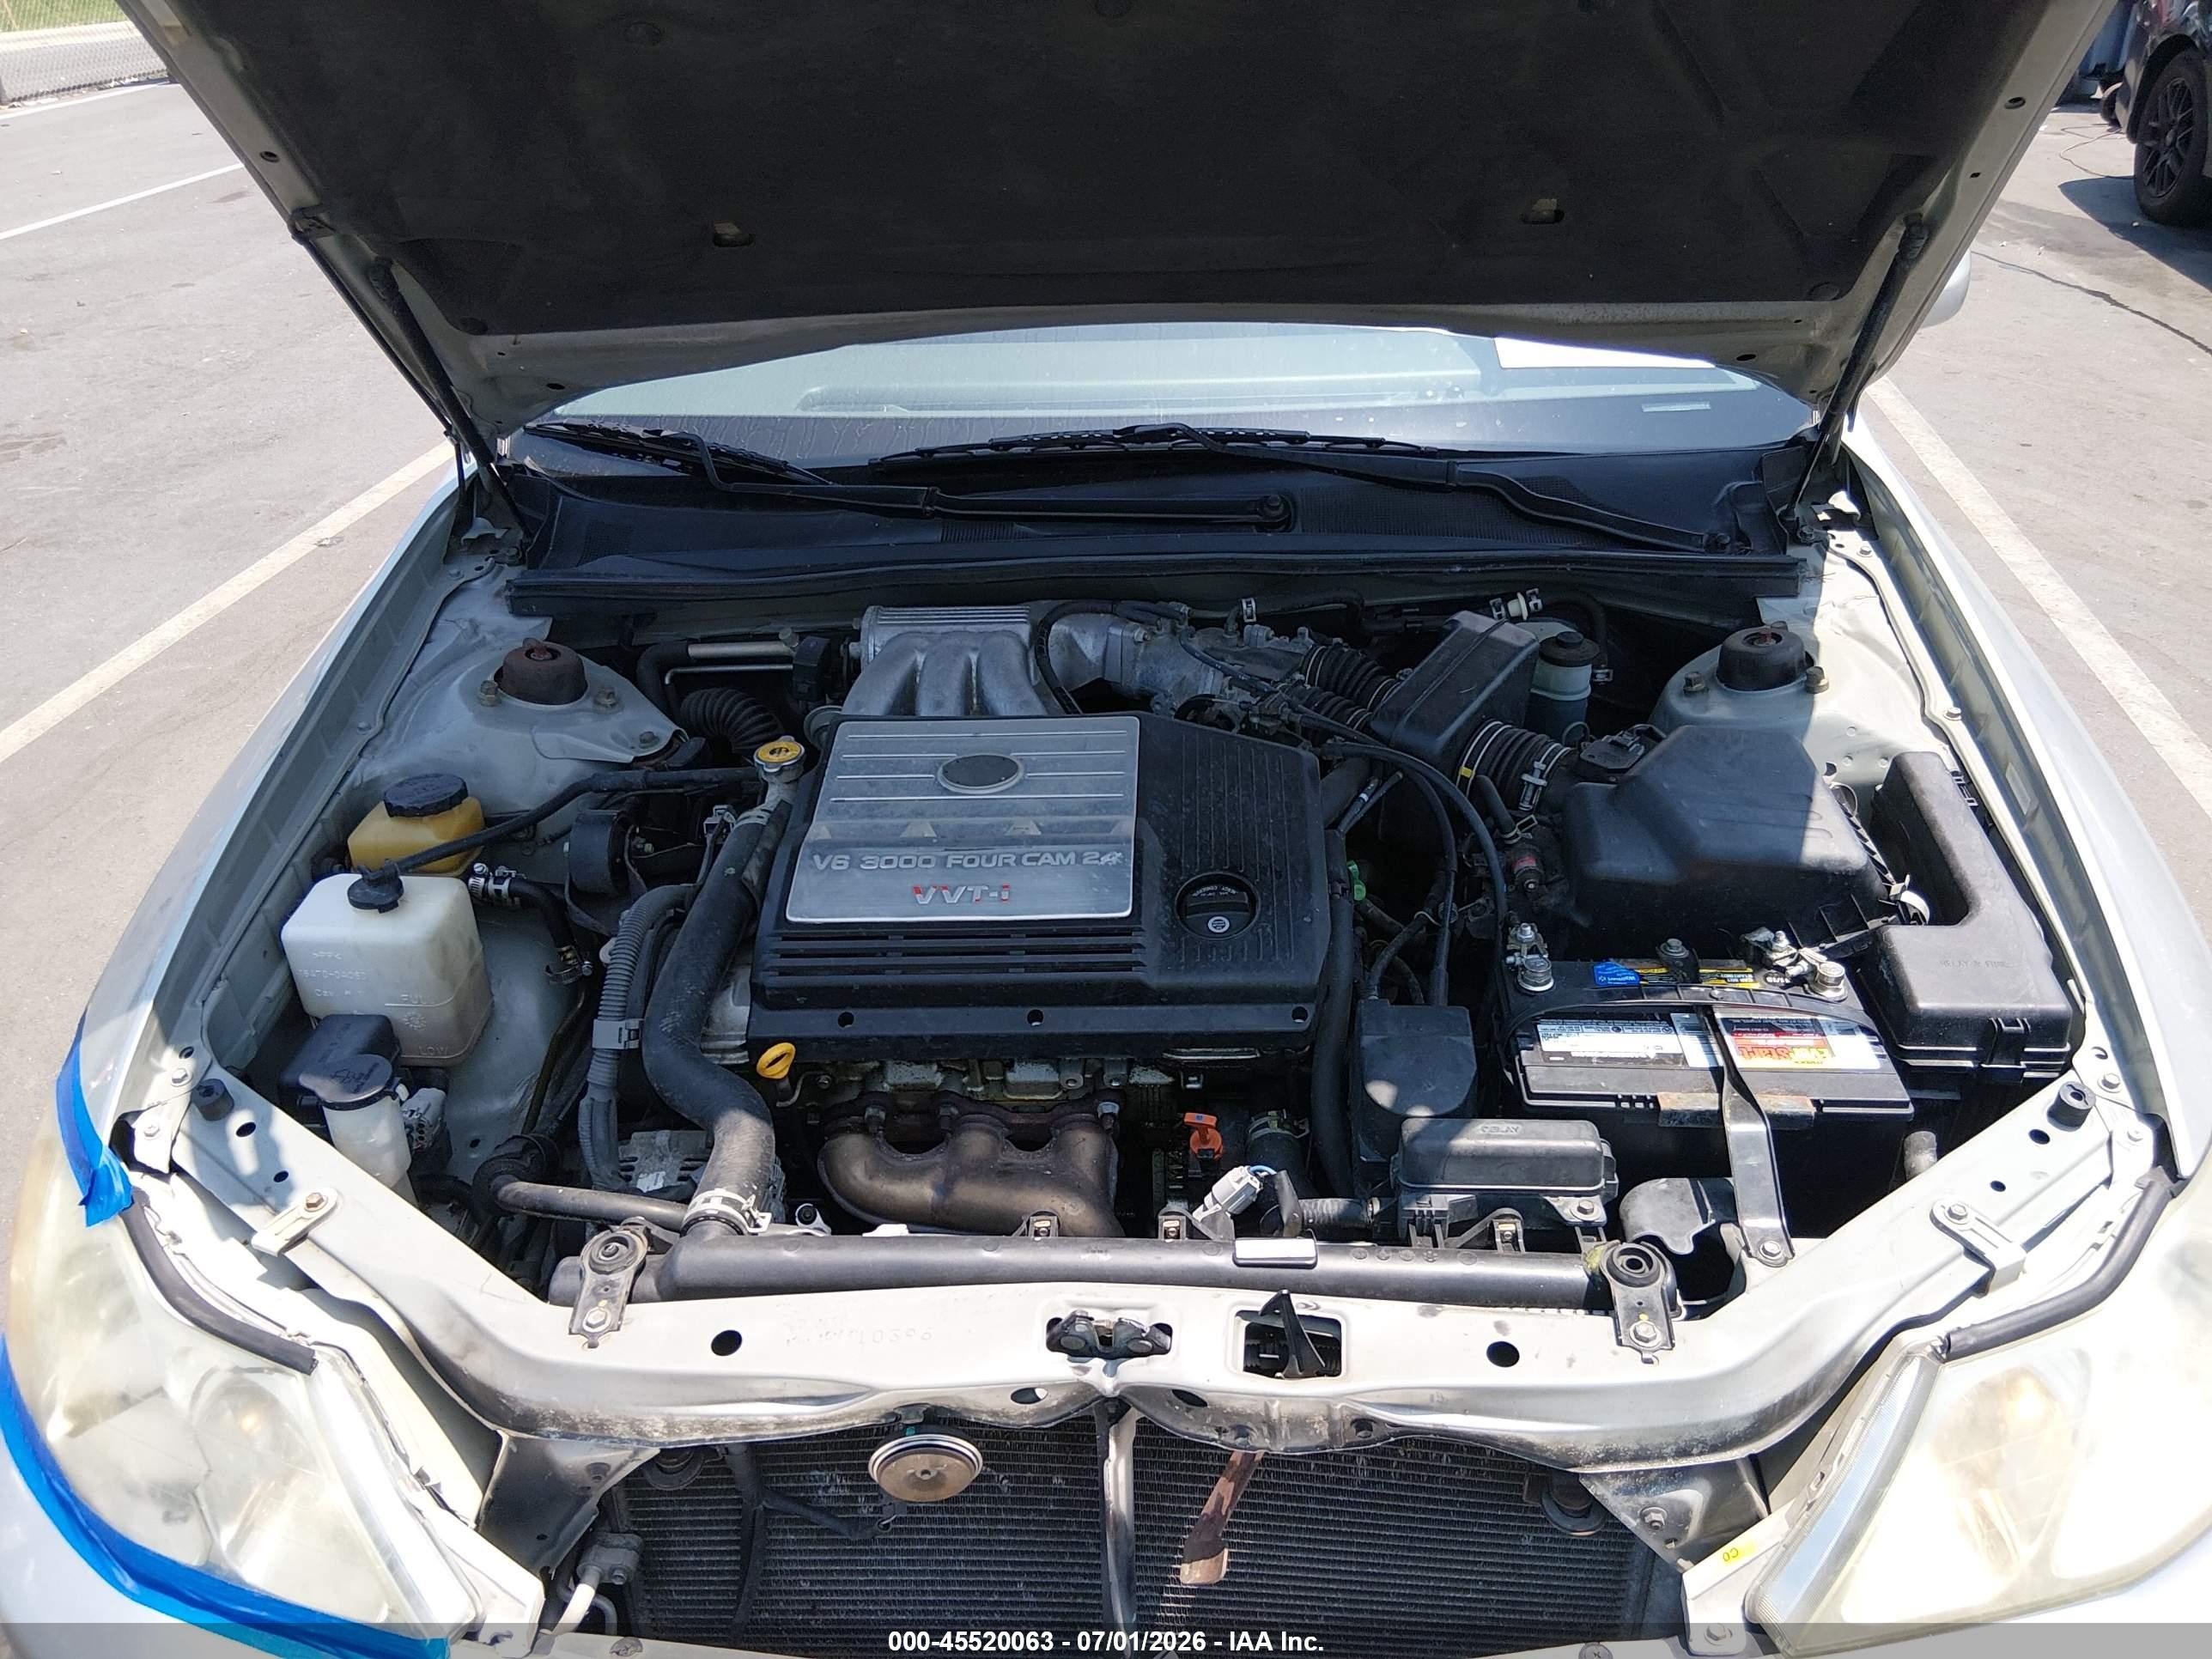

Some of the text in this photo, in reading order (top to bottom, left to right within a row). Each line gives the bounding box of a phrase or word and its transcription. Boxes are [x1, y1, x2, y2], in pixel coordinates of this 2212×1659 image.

[812, 855, 850, 870] V6
[860, 854, 936, 870] 3000
[946, 854, 1017, 869] FOUR
[1021, 851, 1076, 866] CAM
[912, 884, 1011, 905] VVT-i
